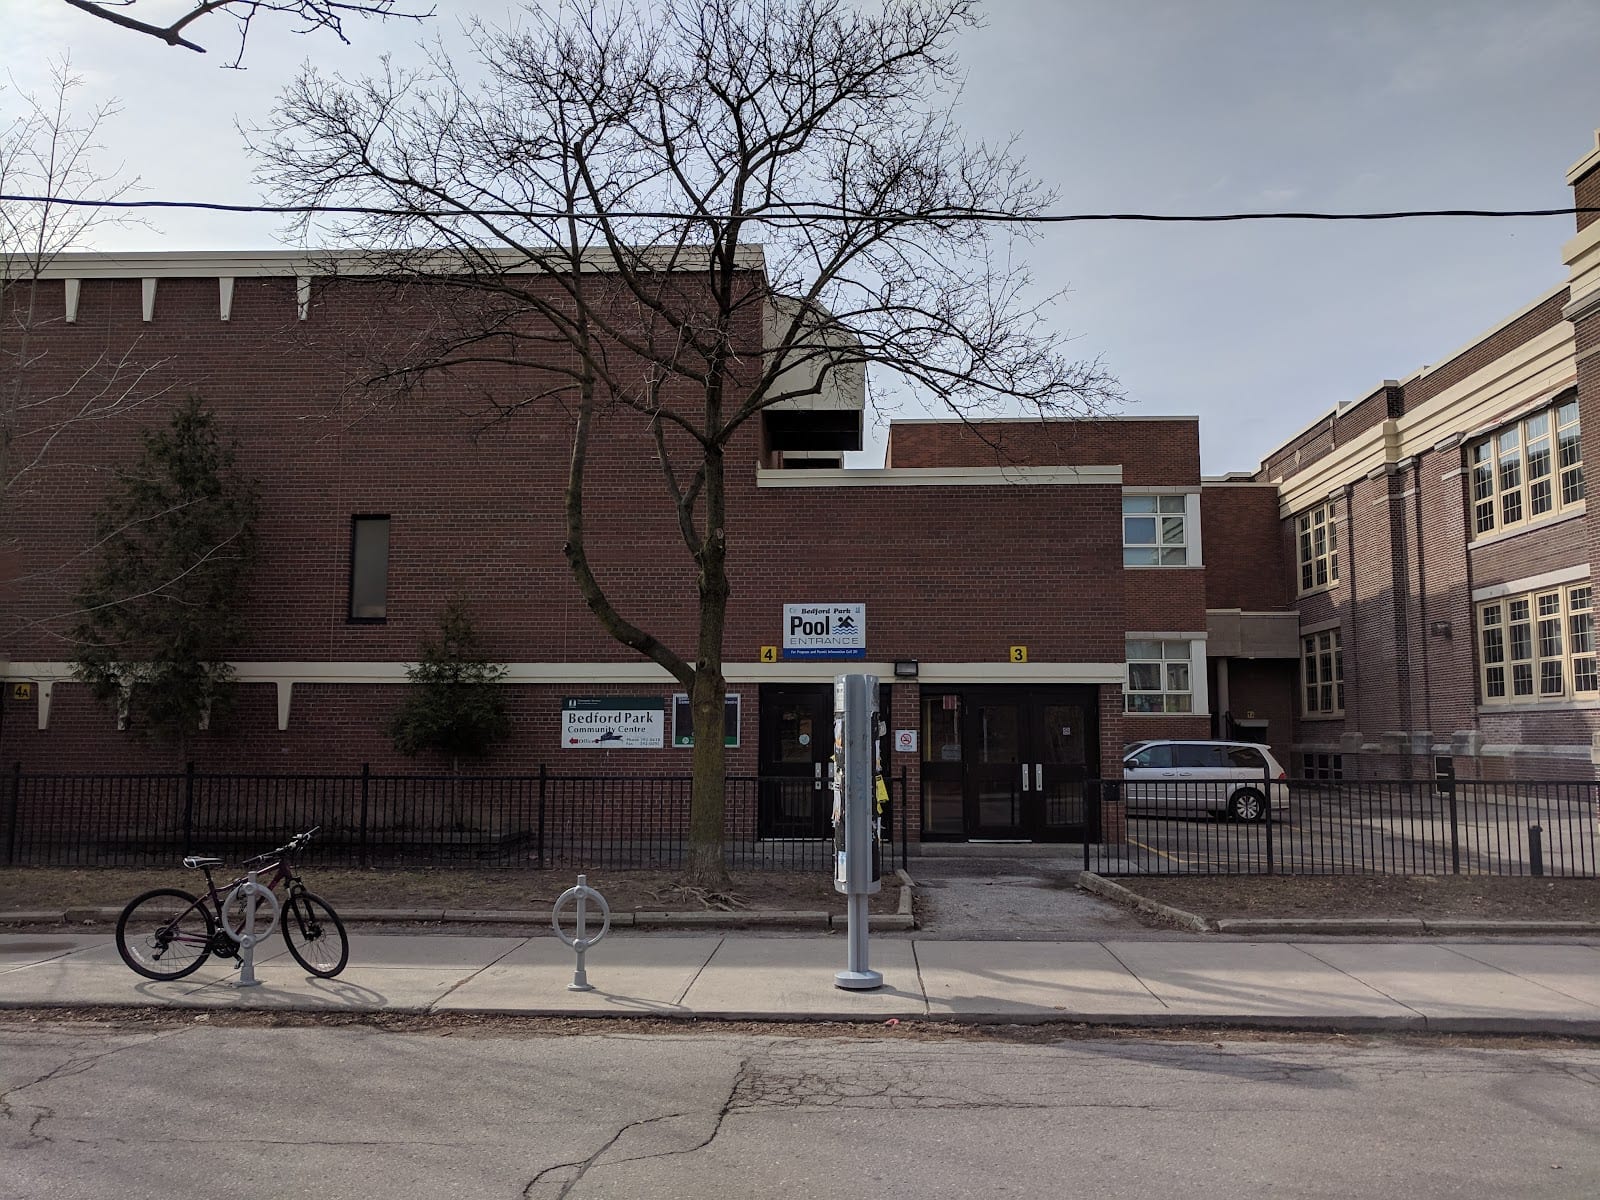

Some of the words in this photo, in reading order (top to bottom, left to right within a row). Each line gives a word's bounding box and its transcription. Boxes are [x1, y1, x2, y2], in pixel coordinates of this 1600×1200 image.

[790, 615, 830, 636] Pool
[790, 637, 859, 645] ENTRANCE
[764, 648, 773, 661] 4
[1014, 648, 1023, 661] 3
[15, 685, 29, 698] 4A
[568, 711, 621, 723] Bedford
[624, 711, 654, 723] Park
[567, 725, 616, 734] Community
[618, 725, 646, 733] Centre
